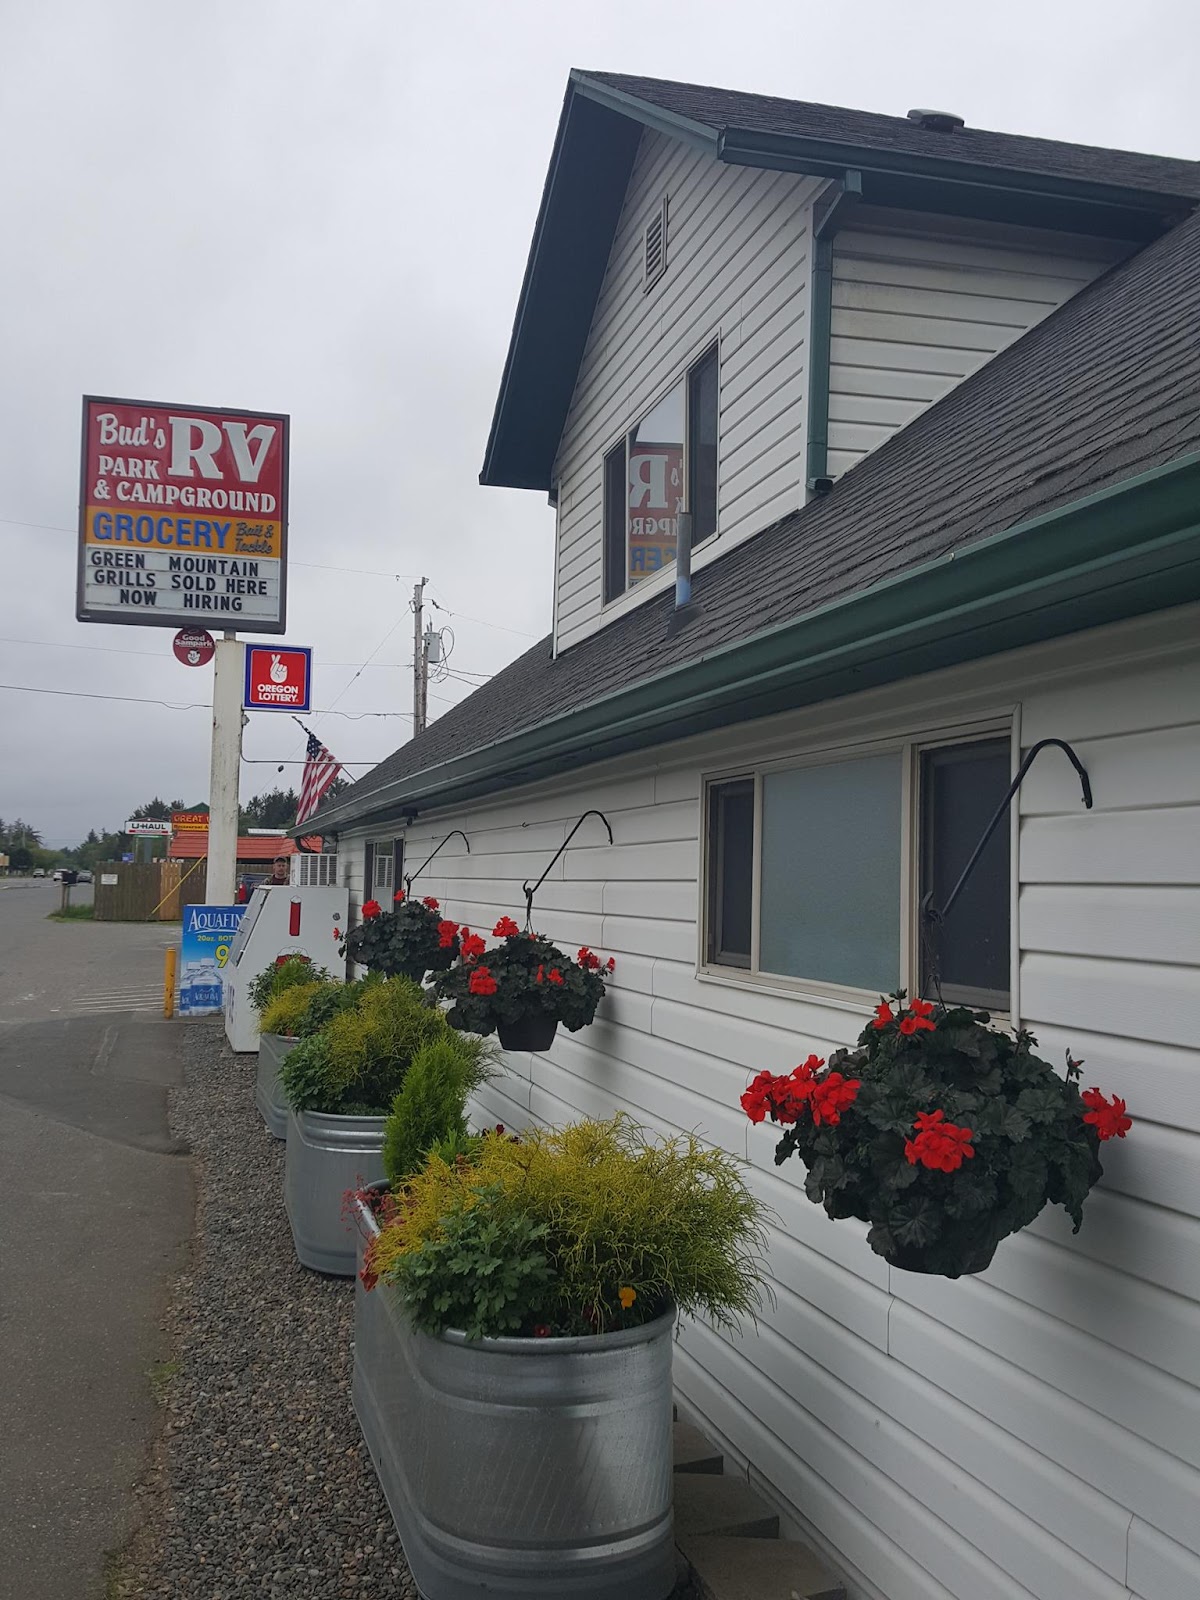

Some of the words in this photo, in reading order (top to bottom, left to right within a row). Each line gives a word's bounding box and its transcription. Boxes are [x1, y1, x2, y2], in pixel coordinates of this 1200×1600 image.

[97, 413, 166, 449] Bud's
[168, 416, 276, 483] RV
[99, 455, 160, 480] PARK
[94, 479, 111, 500] &
[116, 480, 276, 513] CAMPGROUND
[93, 512, 231, 549] GROCERY
[236, 522, 263, 538] Bait
[264, 525, 274, 539] &
[91, 551, 145, 569] GREEN
[169, 556, 259, 577] MOUNTAIN
[94, 569, 156, 587] GRILLS
[171, 574, 216, 592] SOLD
[226, 579, 268, 596] HERE
[120, 589, 157, 606] NOW
[183, 593, 243, 612] HIRING
[182, 634, 206, 642] Good
[257, 683, 299, 694] OREGON
[258, 692, 298, 703] LOTTERY
[131, 822, 167, 830] U-HAUL
[173, 814, 204, 823] GREAT
